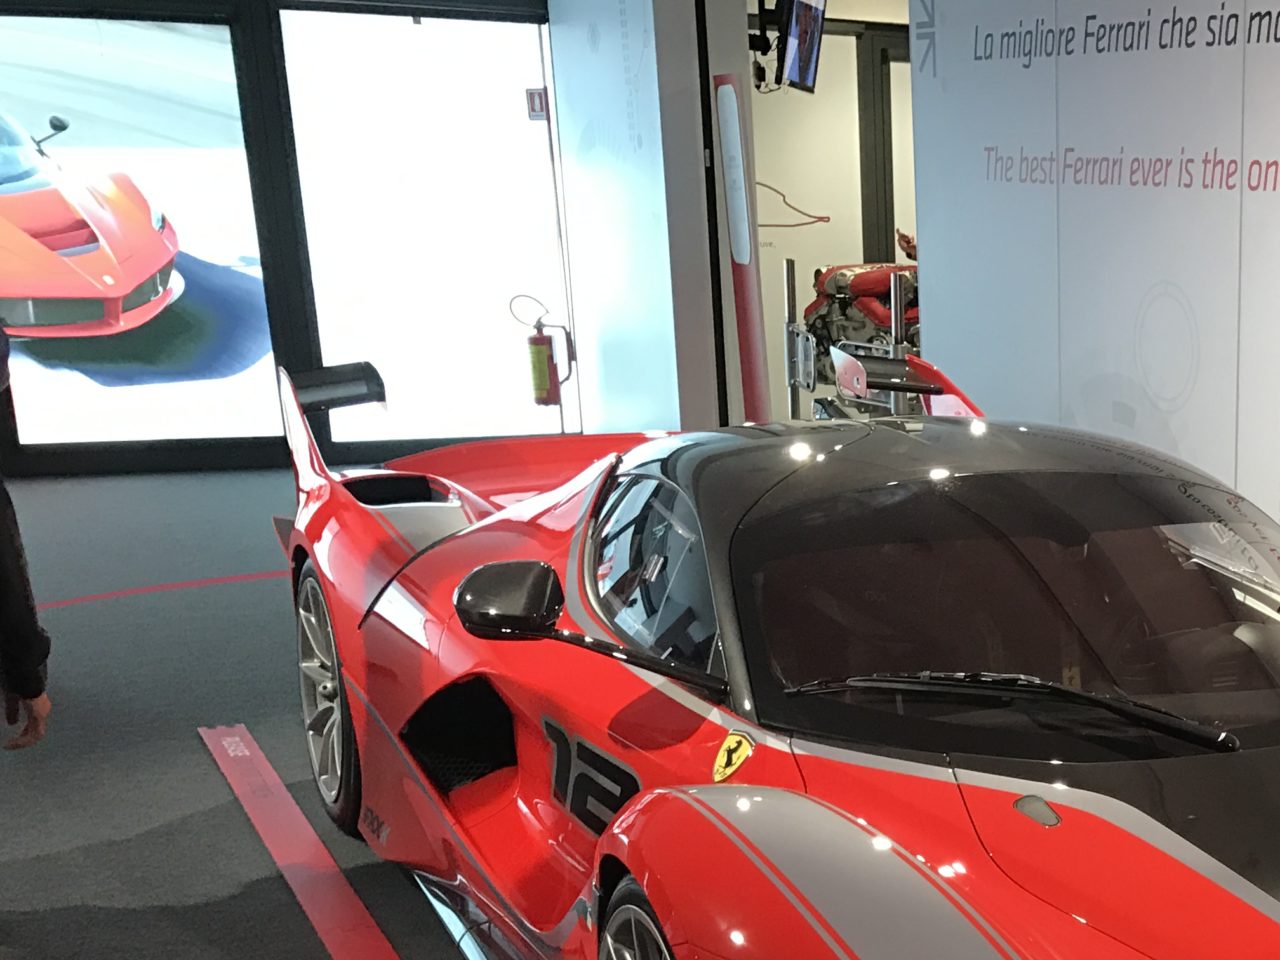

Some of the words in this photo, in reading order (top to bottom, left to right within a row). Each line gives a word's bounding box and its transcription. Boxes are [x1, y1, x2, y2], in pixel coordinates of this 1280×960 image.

[974, 25, 993, 60] La
[1000, 19, 1076, 69] migliore
[1083, 8, 1151, 54] Ferrari
[1158, 6, 1197, 49] che
[1205, 2, 1239, 46] sia
[984, 146, 1013, 183] The
[1019, 146, 1055, 185] best
[1062, 146, 1124, 186] Ferrari
[1129, 157, 1172, 187] ever
[1177, 147, 1194, 188] is
[1202, 147, 1238, 190] the
[541, 714, 641, 839] 12
